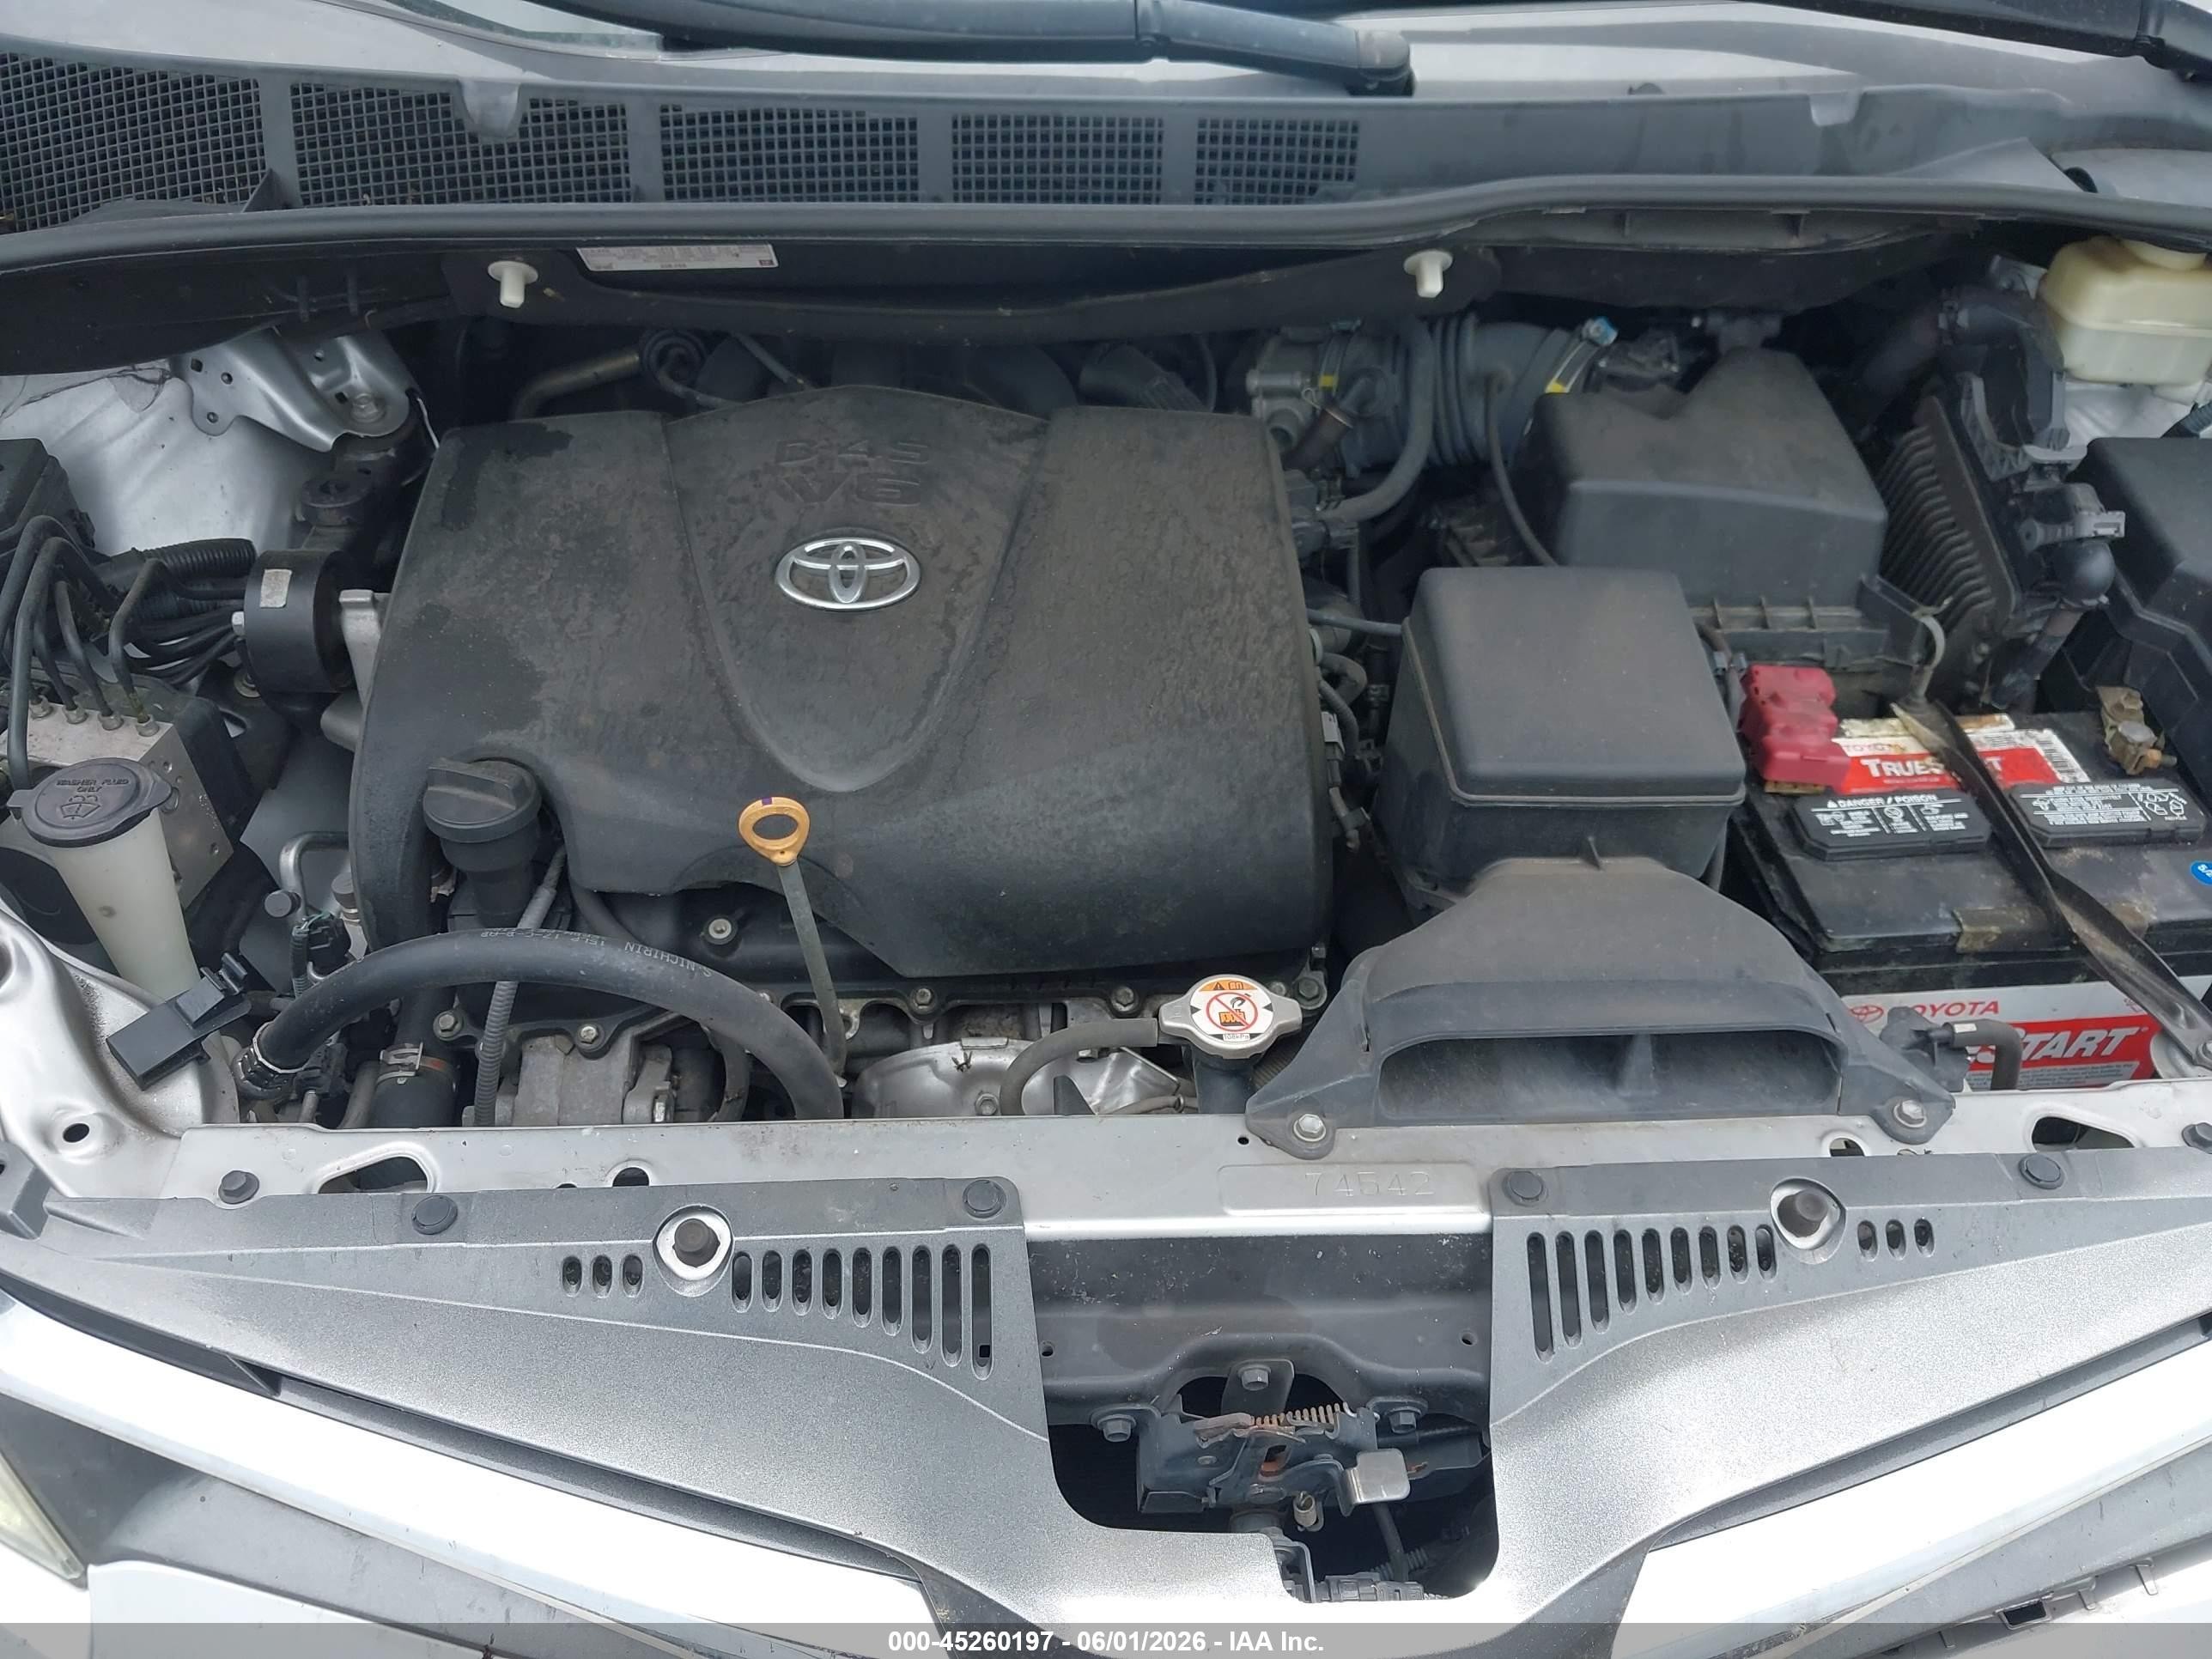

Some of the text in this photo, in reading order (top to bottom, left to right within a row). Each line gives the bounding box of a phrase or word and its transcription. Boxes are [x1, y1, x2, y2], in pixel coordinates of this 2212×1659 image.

[779, 472, 923, 507] V6
[57, 778, 97, 787] WASHER
[1839, 797, 1884, 808] DANGER
[1895, 793, 1938, 804] POISON
[1913, 1000, 2000, 1018] OYOTA
[1304, 1171, 1436, 1197] 74542
